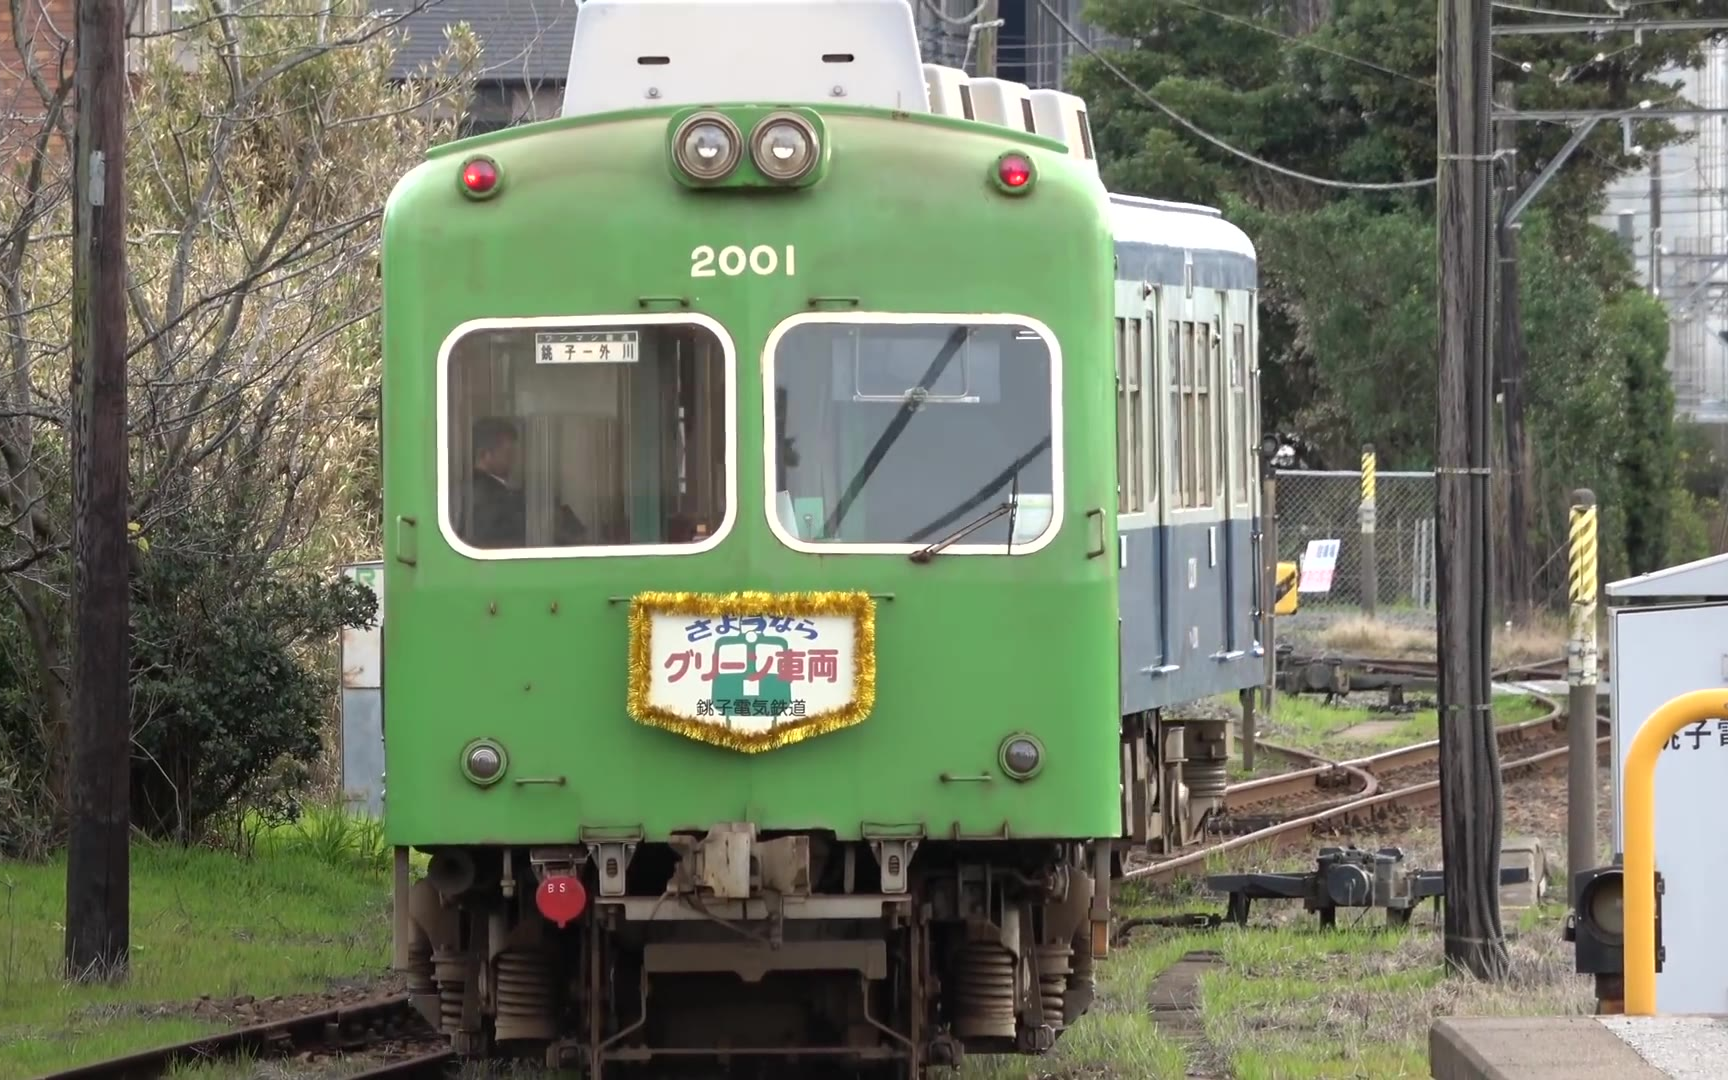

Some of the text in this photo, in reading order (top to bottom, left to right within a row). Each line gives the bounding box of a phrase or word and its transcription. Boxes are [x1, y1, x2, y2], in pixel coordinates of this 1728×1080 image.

[691, 244, 795, 278] 2001
[664, 649, 839, 683] グリーン車両
[696, 699, 807, 717] 銚子電気鉄道
